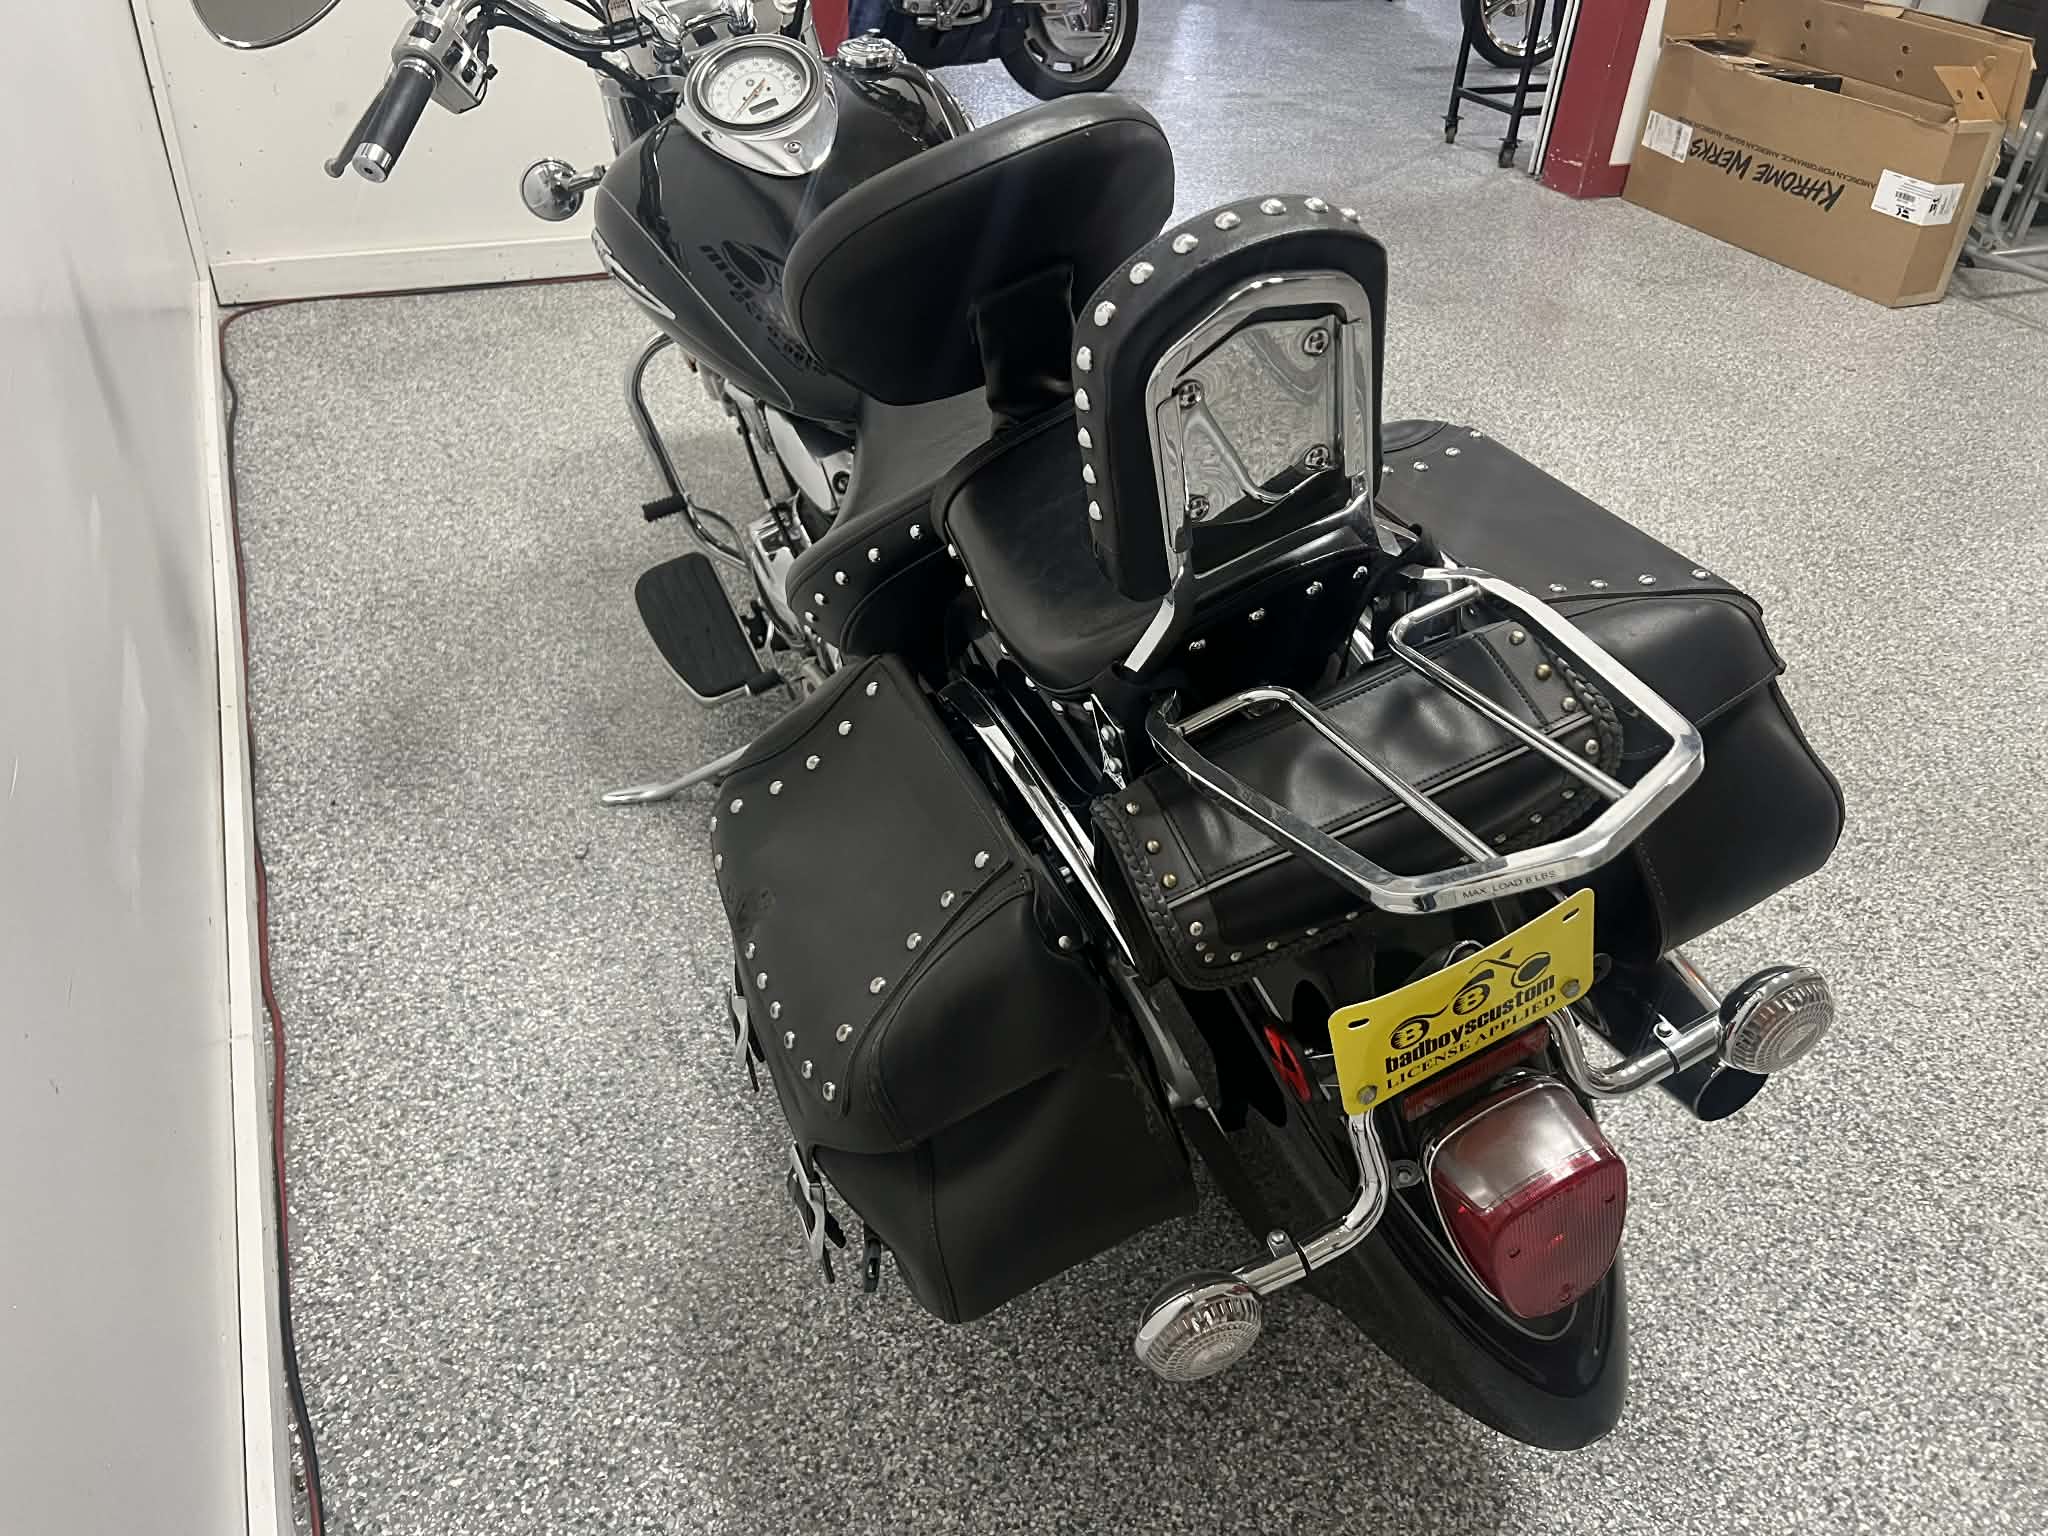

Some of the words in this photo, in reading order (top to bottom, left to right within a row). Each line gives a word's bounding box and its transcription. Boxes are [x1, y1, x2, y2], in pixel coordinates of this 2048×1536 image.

[1688, 138, 1752, 180] WERKS
[1752, 162, 1845, 212] KHROME
[1462, 887, 1488, 899] MAX
[1492, 880, 1523, 892] LOAD
[1385, 975, 1555, 1075] badboyscustom
[1387, 1040, 1471, 1089] LICENSE
[1475, 994, 1556, 1045] APPLIED
